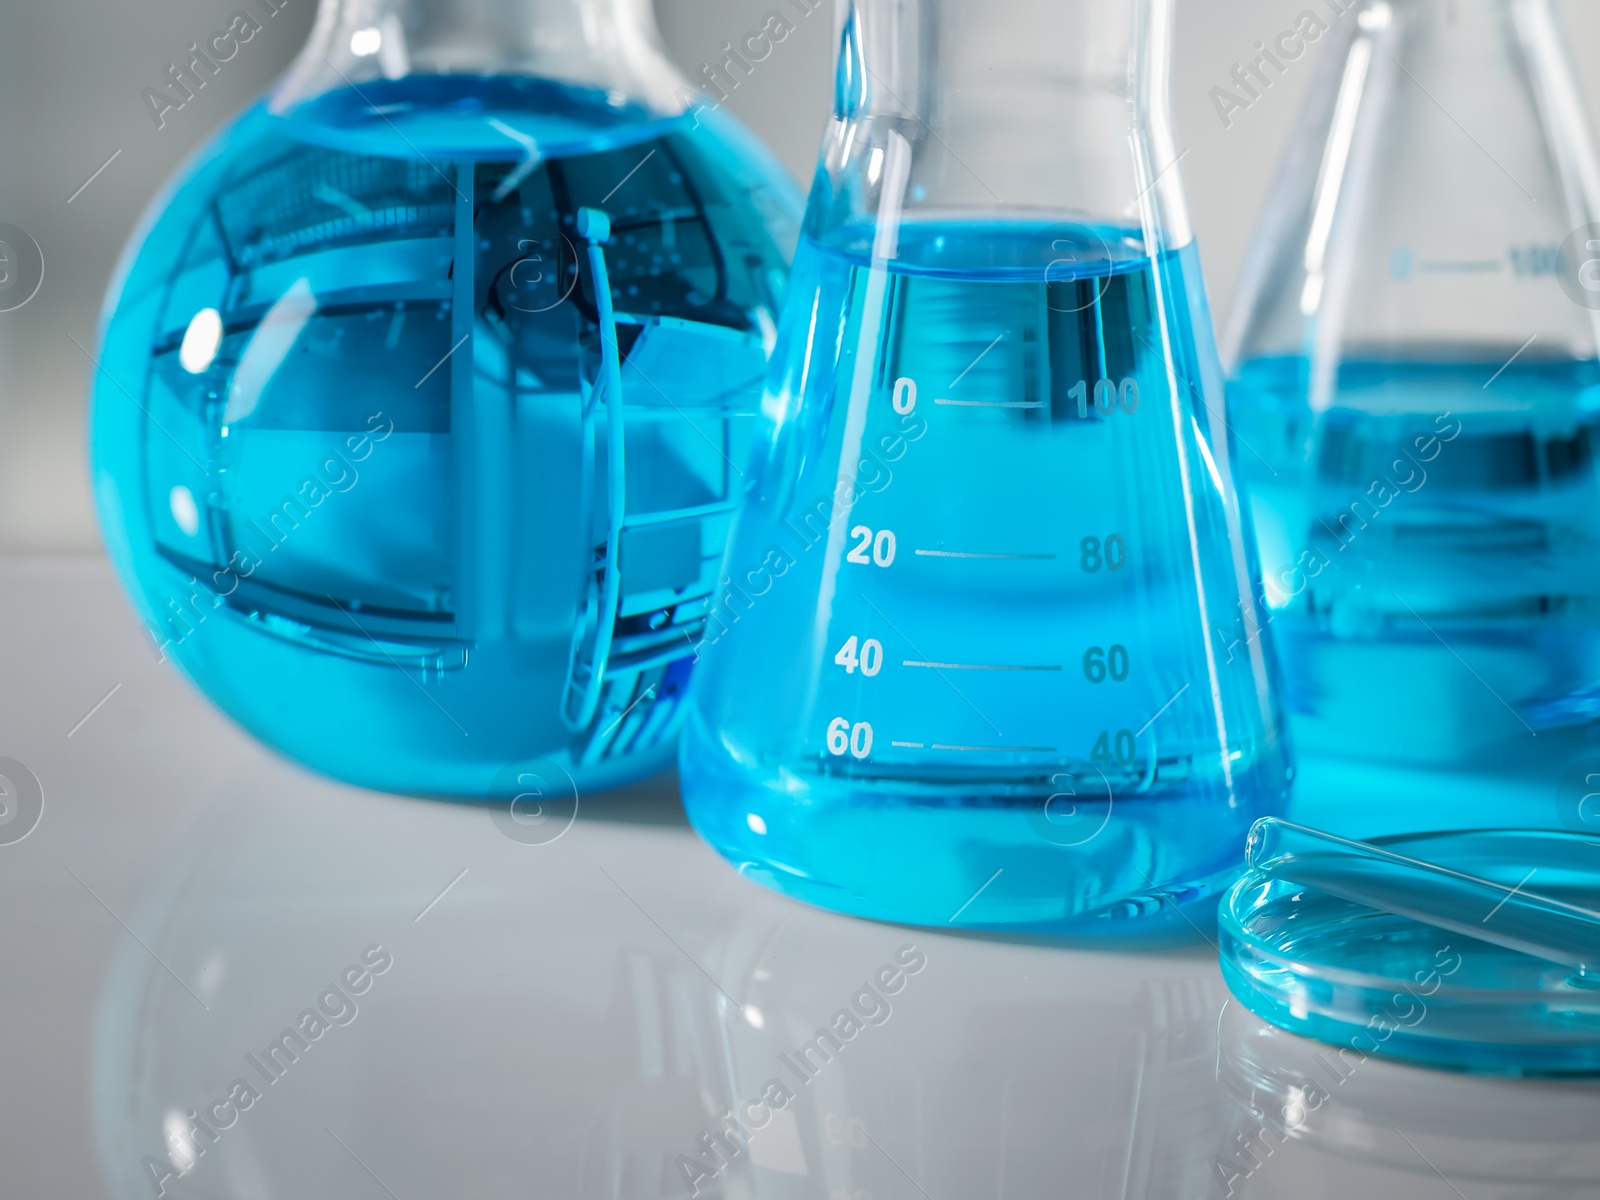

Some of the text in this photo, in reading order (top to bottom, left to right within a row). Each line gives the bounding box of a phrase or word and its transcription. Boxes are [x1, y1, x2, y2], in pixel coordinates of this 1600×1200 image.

[892, 377, 1139, 418] 0 100
[846, 525, 1126, 573] 20 80
[834, 635, 1129, 684] 40 60
[826, 717, 1136, 768] 60 40
